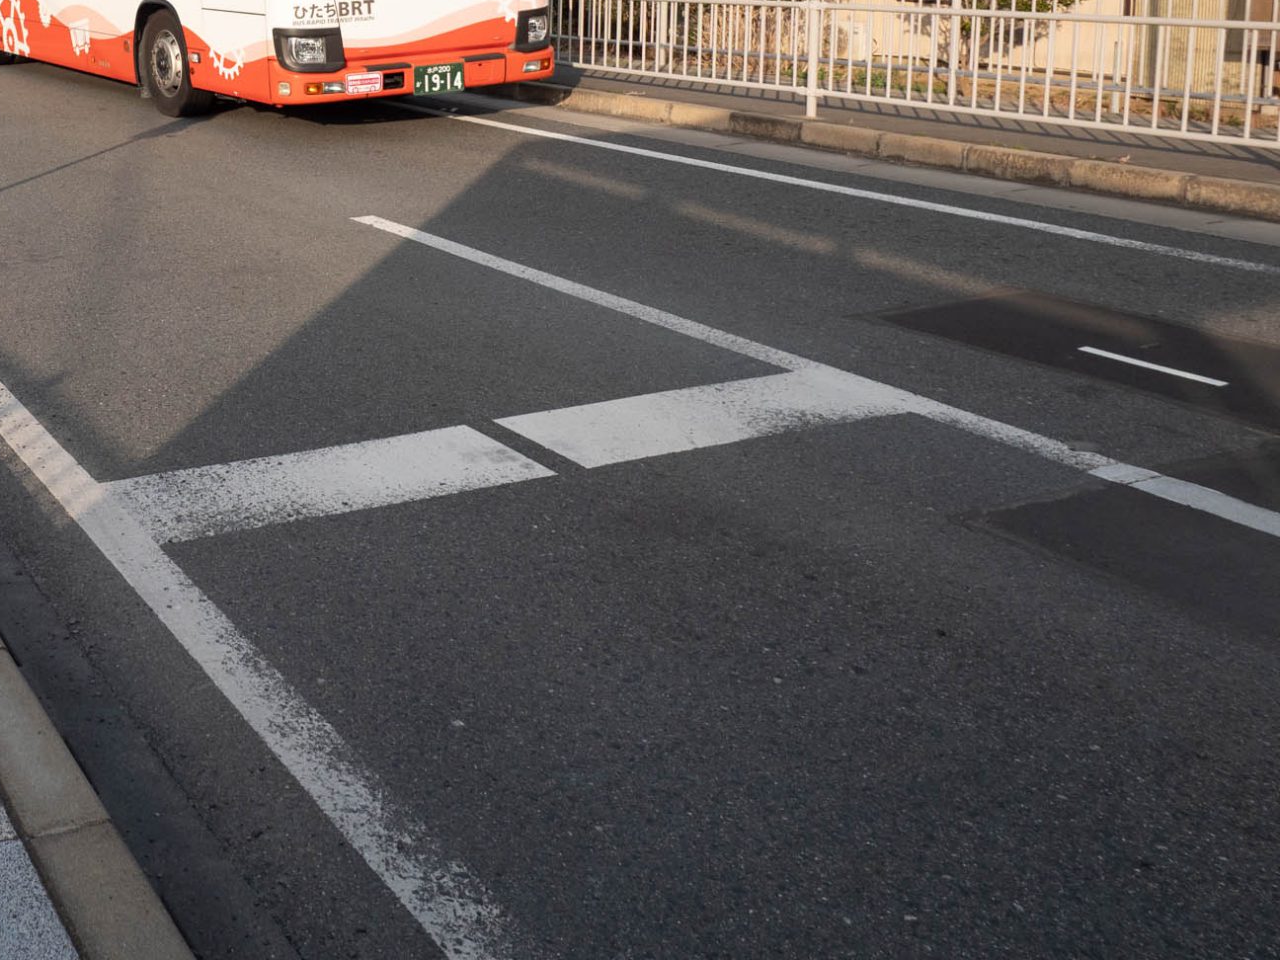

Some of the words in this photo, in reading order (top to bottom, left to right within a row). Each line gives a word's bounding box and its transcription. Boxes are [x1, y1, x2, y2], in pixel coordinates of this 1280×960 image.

[293, 0, 375, 20] ひたちBRT
[424, 71, 463, 92] 19-14
